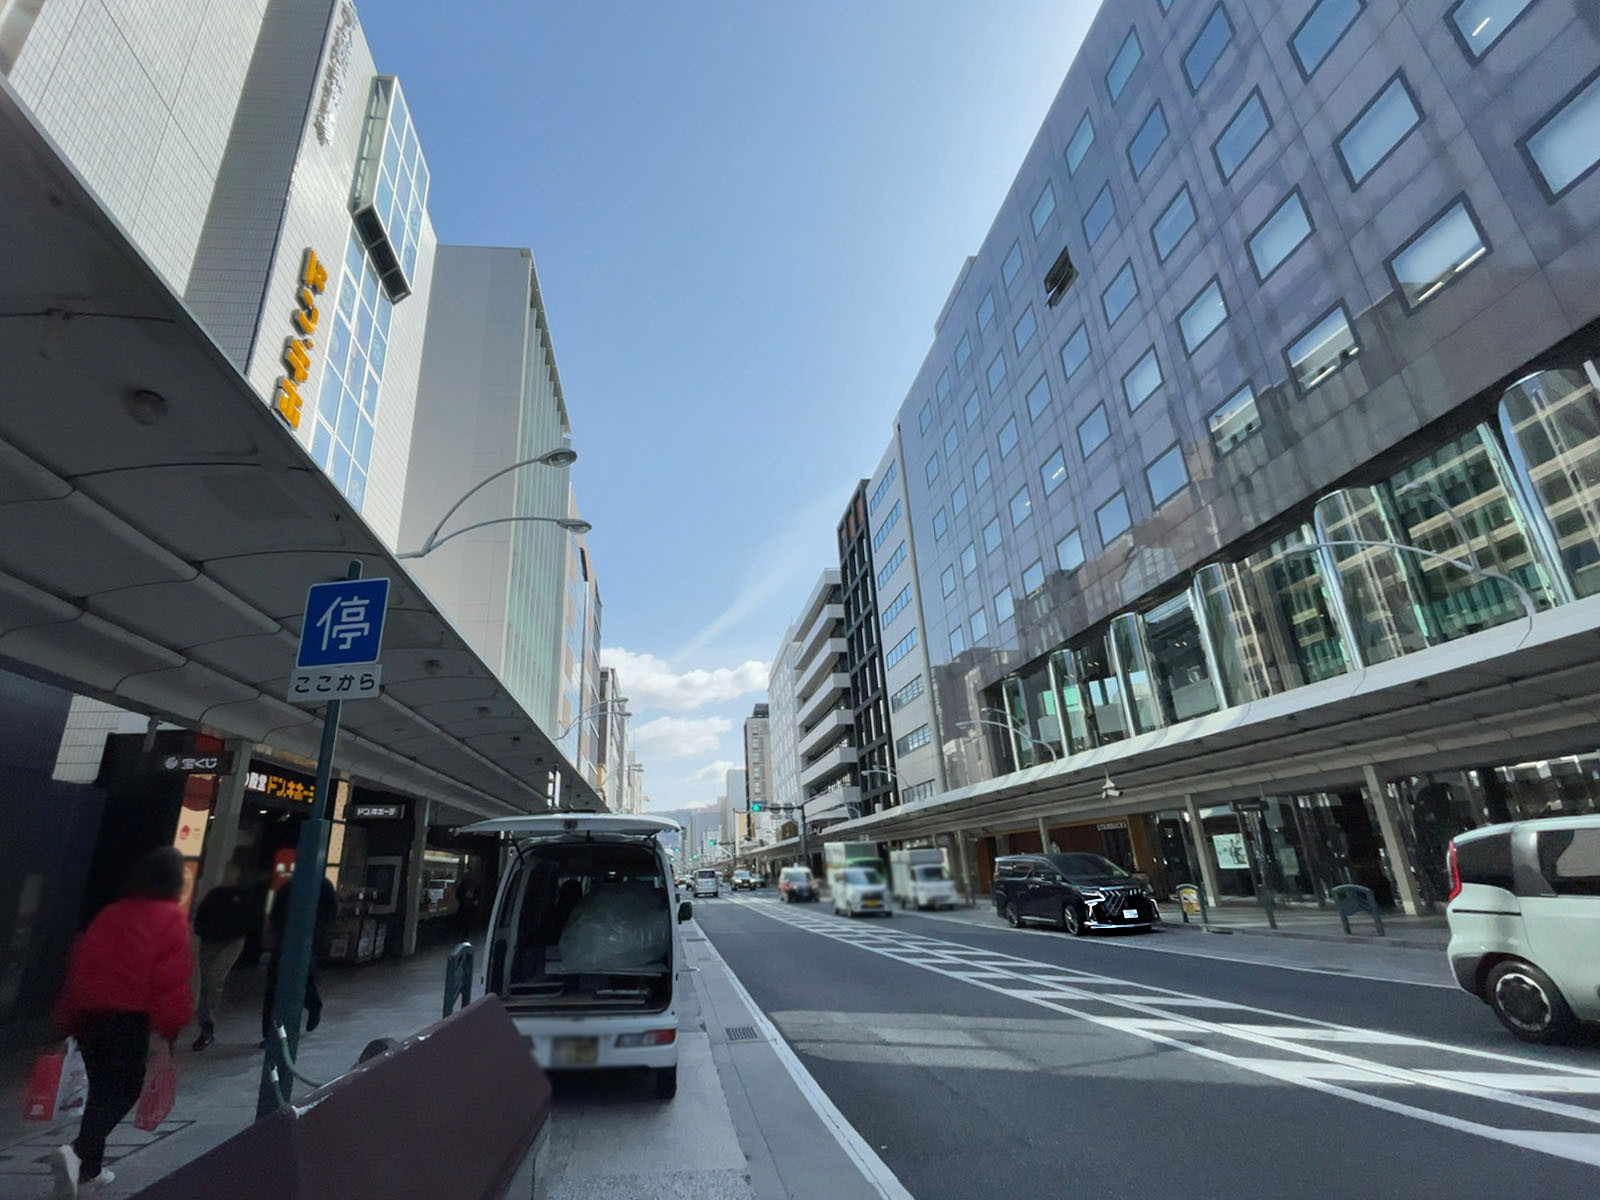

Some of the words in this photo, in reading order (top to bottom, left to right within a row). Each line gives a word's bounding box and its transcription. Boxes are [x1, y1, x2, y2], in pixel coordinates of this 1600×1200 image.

[316, 595, 370, 651] 停
[295, 673, 375, 693] ここから
